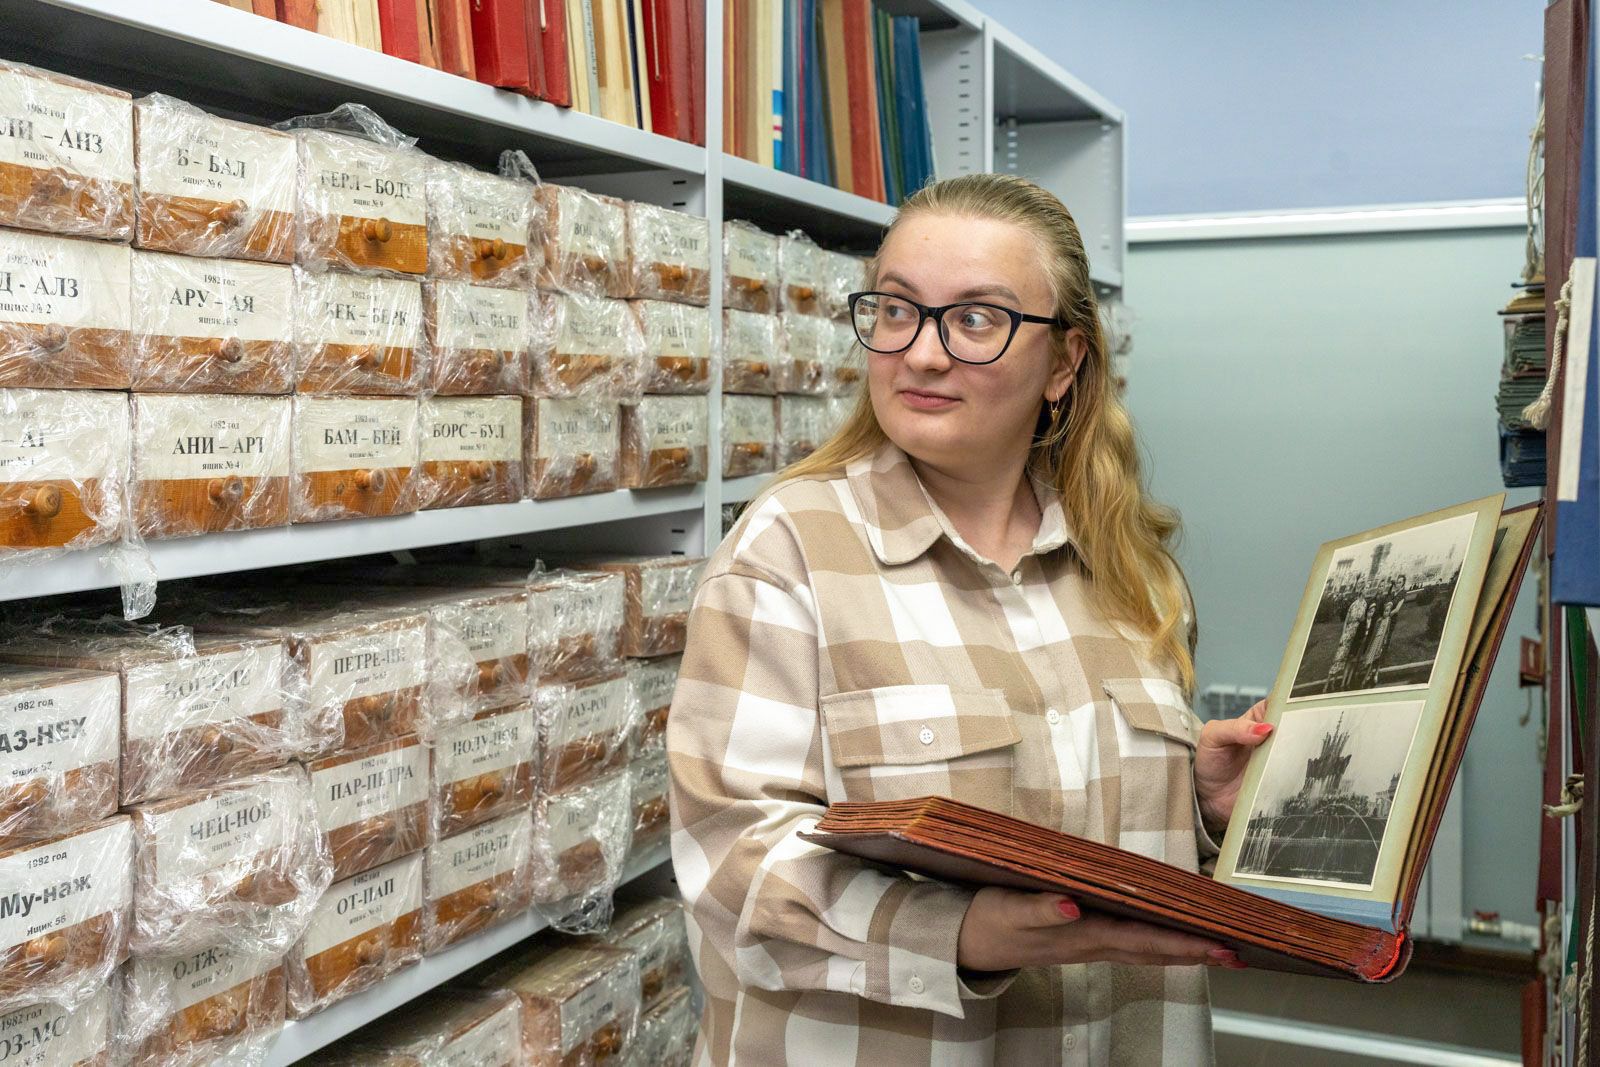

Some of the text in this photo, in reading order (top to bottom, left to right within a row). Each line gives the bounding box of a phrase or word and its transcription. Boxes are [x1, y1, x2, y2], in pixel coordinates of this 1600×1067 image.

[59, 128, 104, 154] АНЗ
[208, 153, 246, 179] БАЛ
[217, 180, 222, 190] 6
[379, 200, 384, 208] 9
[33, 275, 80, 299] АЛЗ
[204, 274, 221, 285] 1982
[169, 286, 211, 308] АРУ
[228, 294, 256, 314] АЯ
[46, 303, 52, 315] 2
[233, 317, 239, 328] 5
[209, 420, 240, 430] 1982 год
[433, 423, 468, 438] БОРС
[480, 424, 504, 439] БУЛ
[323, 428, 358, 446] БАМ
[372, 426, 401, 446] БЕЙ
[172, 436, 215, 455] АНИ
[233, 436, 265, 454] АРТ
[202, 460, 240, 471] ящик № 4
[13, 698, 54, 713] 1982 год
[330, 764, 414, 802] ПАР-ПЕТРА
[52, 851, 68, 862] год
[0, 873, 92, 920] Му-наж
[337, 878, 395, 915] ОТ-ПАП
[26, 920, 53, 936] Ящик
[172, 945, 230, 980] ОЛЖ-
[1, 1008, 42, 1031] 1982 год
